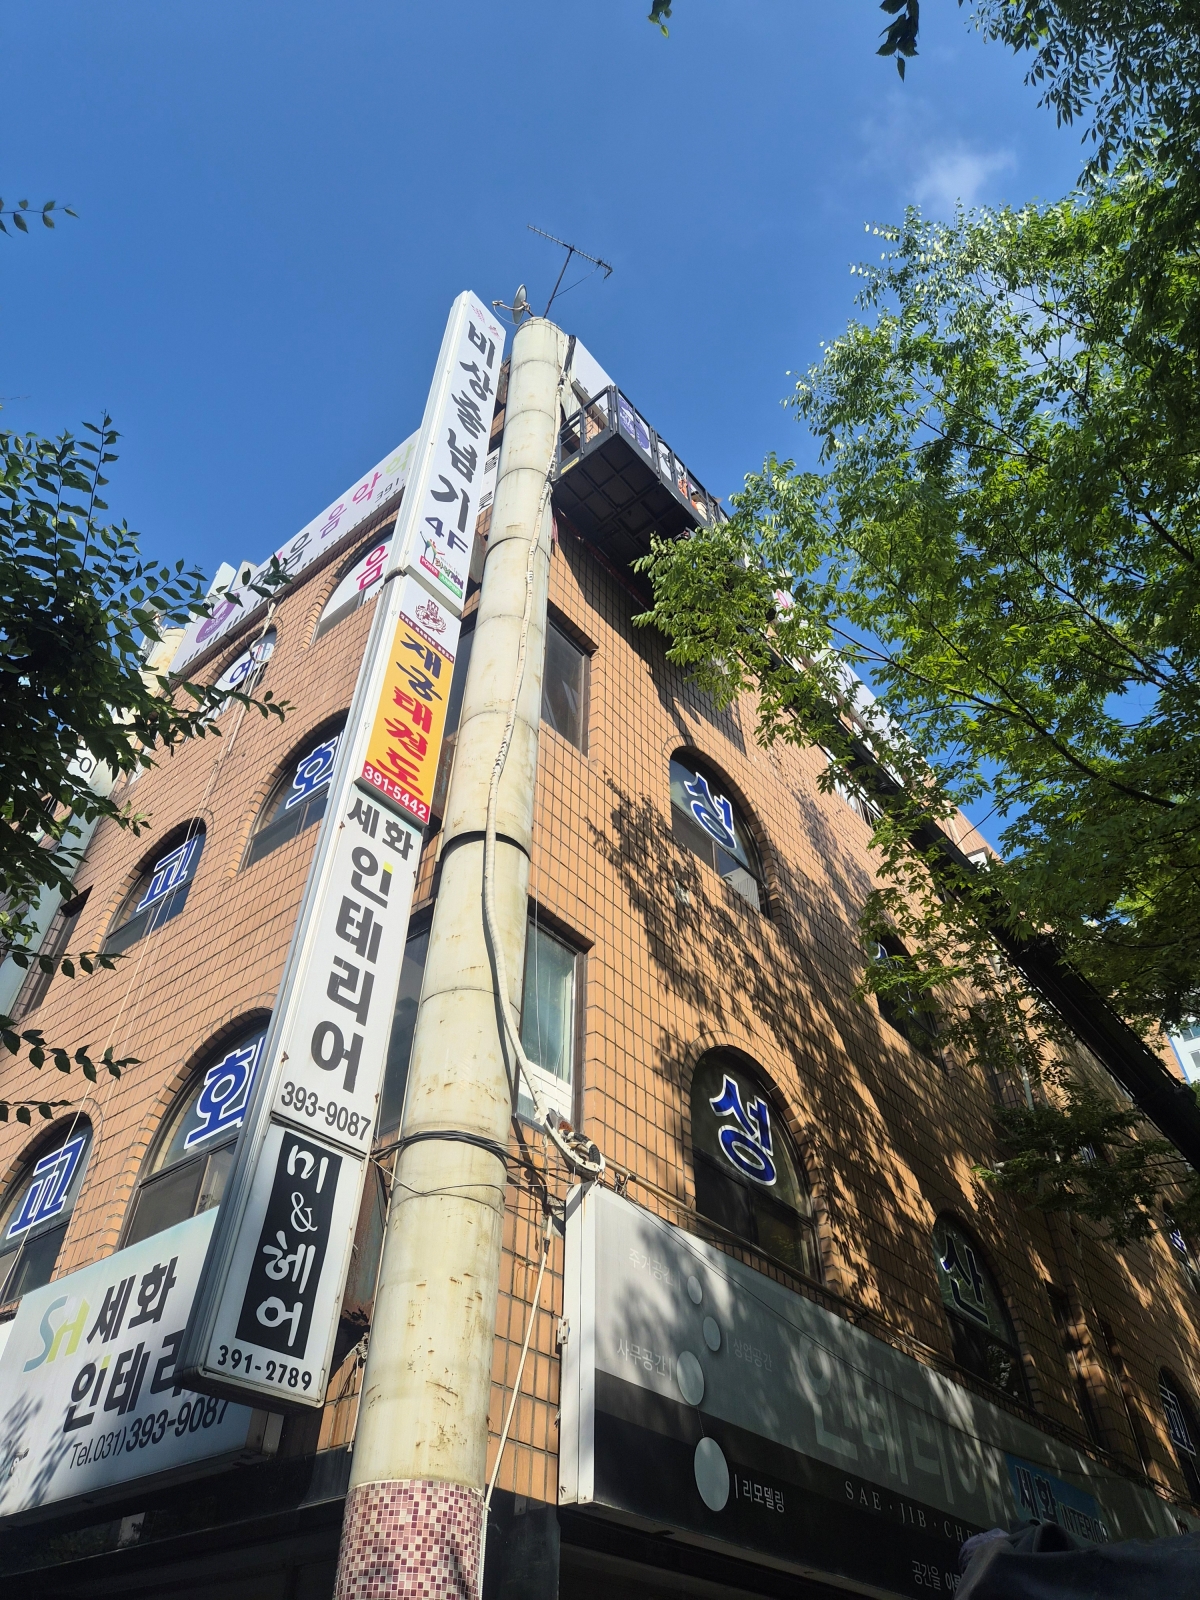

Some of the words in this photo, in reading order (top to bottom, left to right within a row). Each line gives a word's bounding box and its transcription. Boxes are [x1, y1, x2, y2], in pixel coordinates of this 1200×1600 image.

[430, 320, 496, 534] 비상줄넘기
[425, 516, 469, 554] 4F
[356, 545, 389, 591] 음
[375, 632, 443, 796] 재궁태권도
[364, 766, 427, 820] 391-5442
[683, 771, 737, 850] 성
[347, 797, 413, 861] 세화
[136, 839, 199, 913] 교
[311, 846, 394, 1094] 인테리어
[281, 1081, 372, 1142] 393-9087
[709, 1073, 778, 1187] 성
[6, 1135, 89, 1239] 교
[629, 1247, 675, 1287] 주거공간
[939, 1232, 991, 1329] 산
[86, 1255, 179, 1345] 세화
[23, 1294, 91, 1373] SH
[616, 1338, 666, 1377] 사무공간
[733, 1337, 774, 1372] 상업공간
[217, 1344, 313, 1391] 391-2789
[742, 1479, 786, 1514] 리모델링
[845, 1480, 882, 1511] SAE
[900, 1502, 927, 1529] JIB
[1015, 1465, 1059, 1524] 세화
[911, 1560, 942, 1591] 공간을
